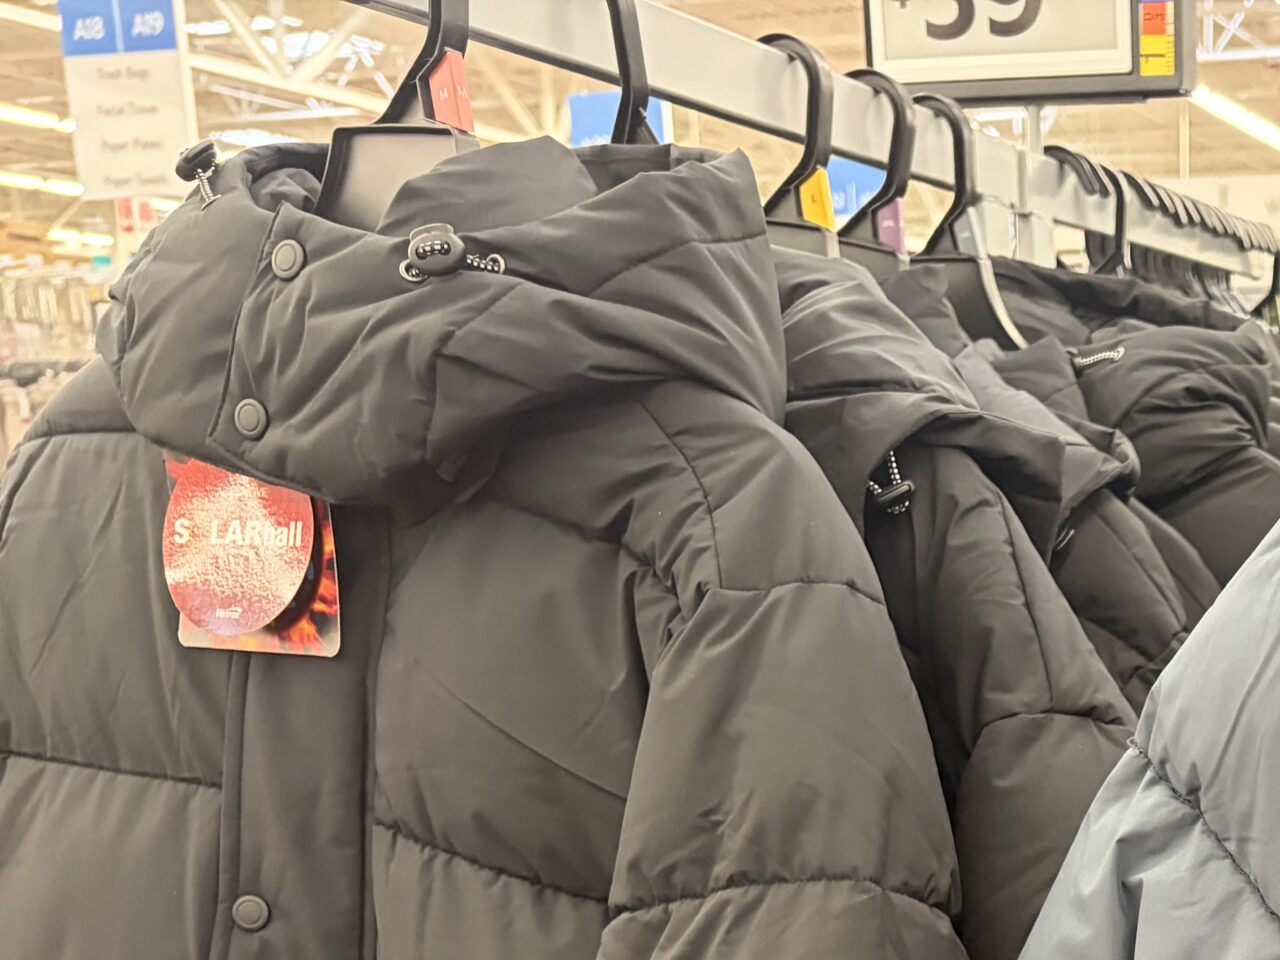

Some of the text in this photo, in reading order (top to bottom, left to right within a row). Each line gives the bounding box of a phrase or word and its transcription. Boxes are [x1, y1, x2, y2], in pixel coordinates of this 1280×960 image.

[73, 16, 105, 40] A18
[132, 11, 164, 36] A19
[173, 518, 303, 547] SLARball
